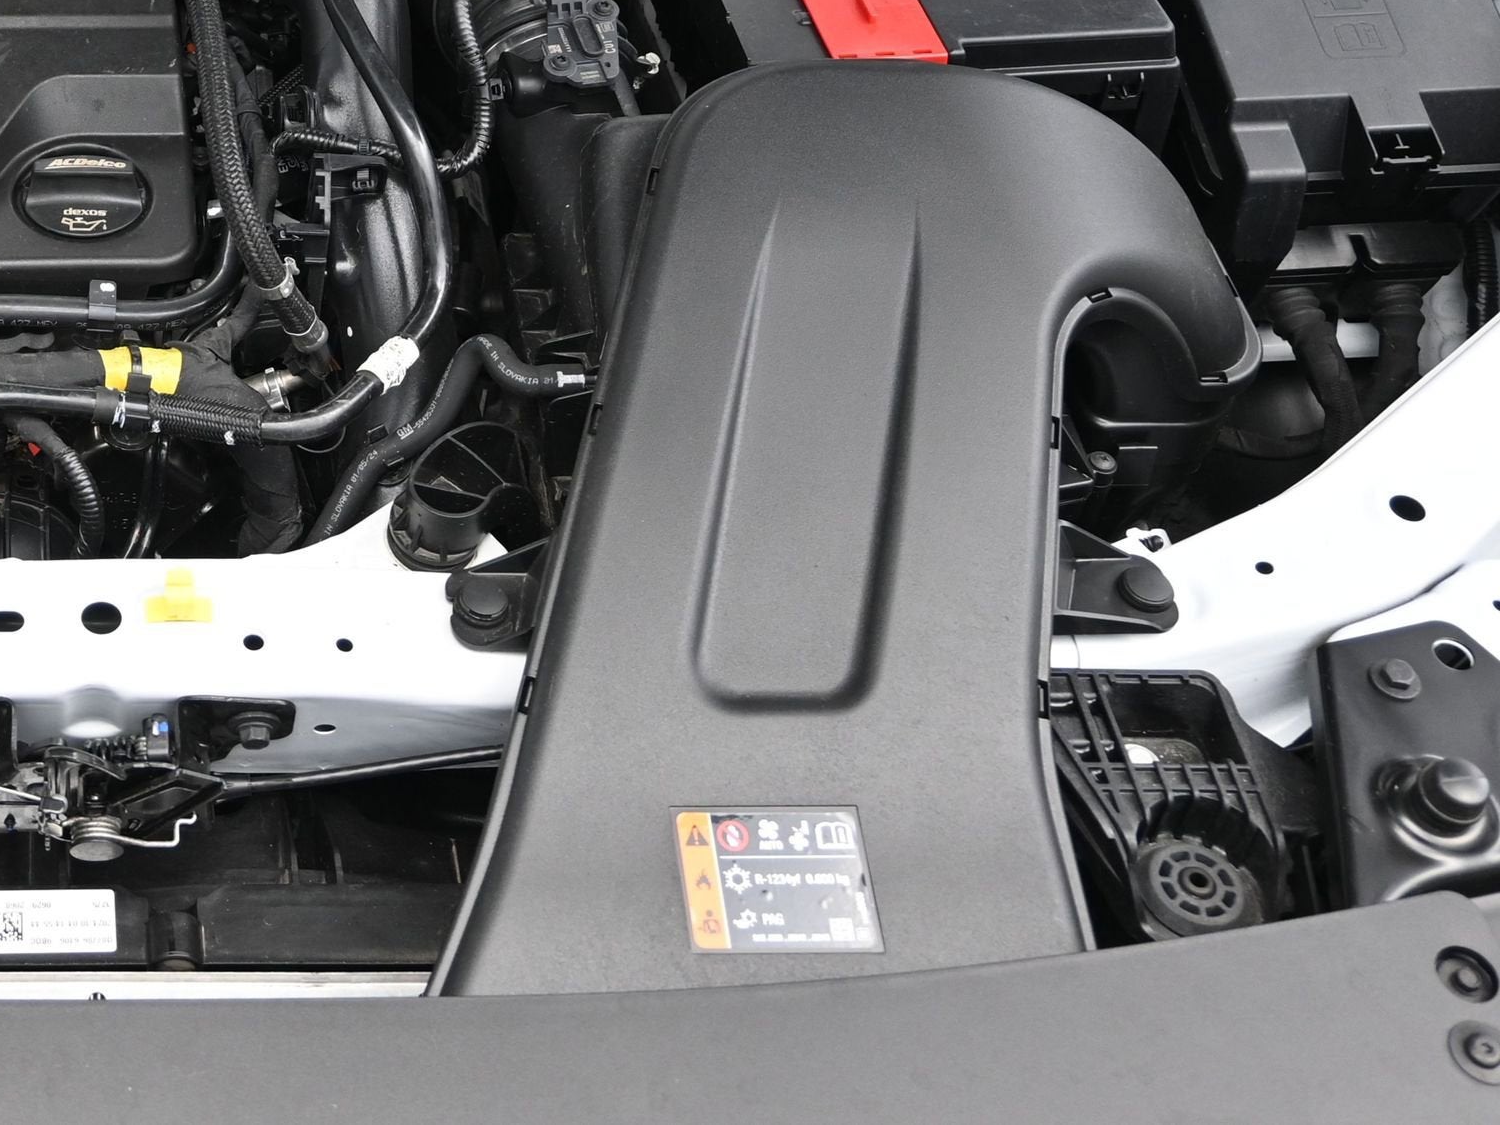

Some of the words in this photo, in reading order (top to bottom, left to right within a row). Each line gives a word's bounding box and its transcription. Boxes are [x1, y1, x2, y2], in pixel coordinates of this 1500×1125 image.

[44, 158, 127, 169] ACDelco
[63, 207, 107, 216] dexos
[498, 362, 539, 385] SLOVAKIA
[331, 484, 353, 522] SLOVAKIA
